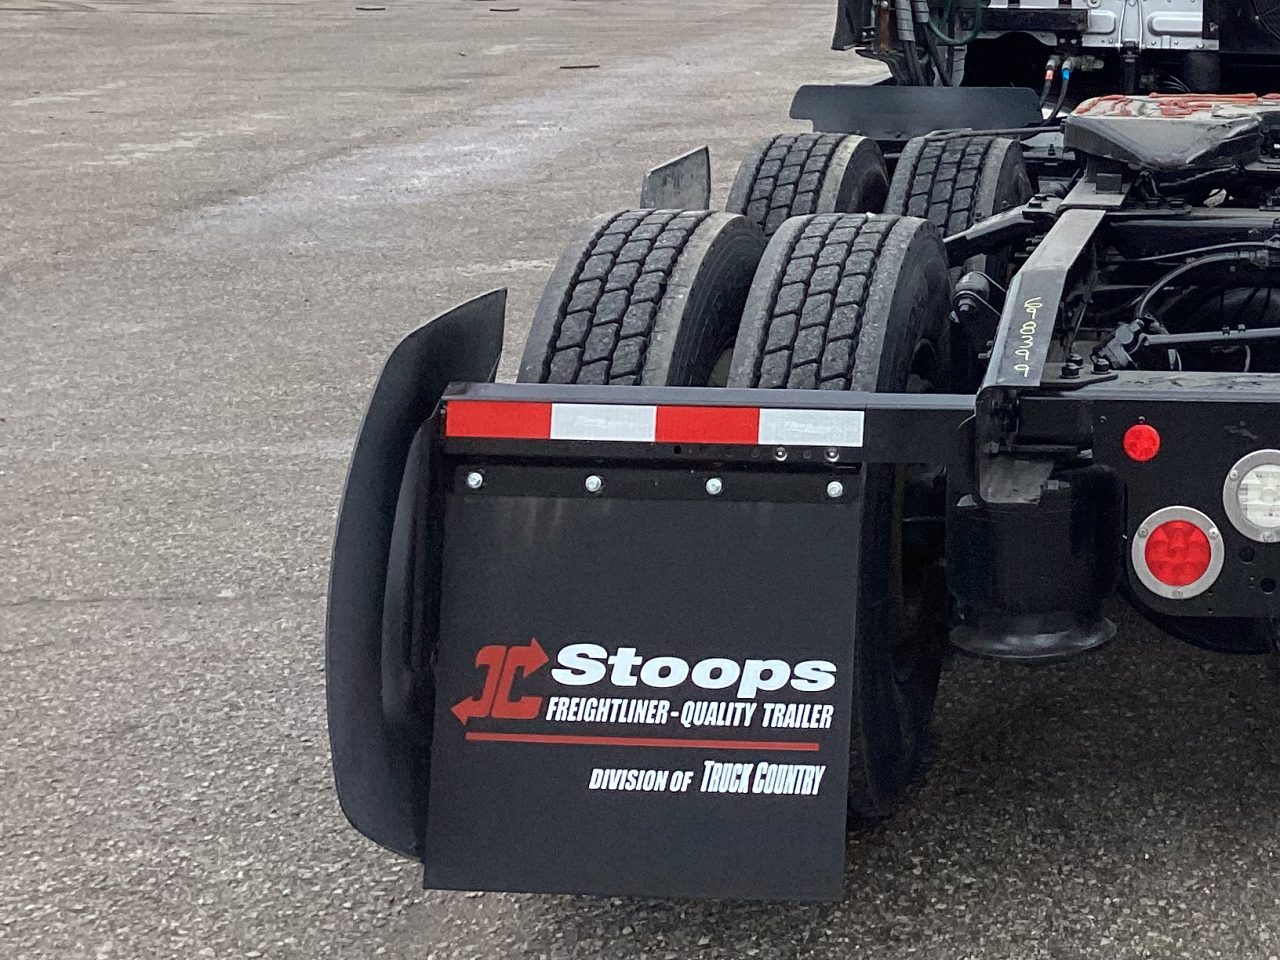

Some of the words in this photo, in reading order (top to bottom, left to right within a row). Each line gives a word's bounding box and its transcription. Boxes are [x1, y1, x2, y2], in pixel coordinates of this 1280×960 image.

[550, 642, 838, 699] Stoops
[761, 702, 835, 729] TRAILER
[588, 768, 670, 792] DIVISION
[669, 770, 694, 792] OF
[699, 759, 755, 794] TRUCK
[752, 761, 827, 796] COUNTRY
